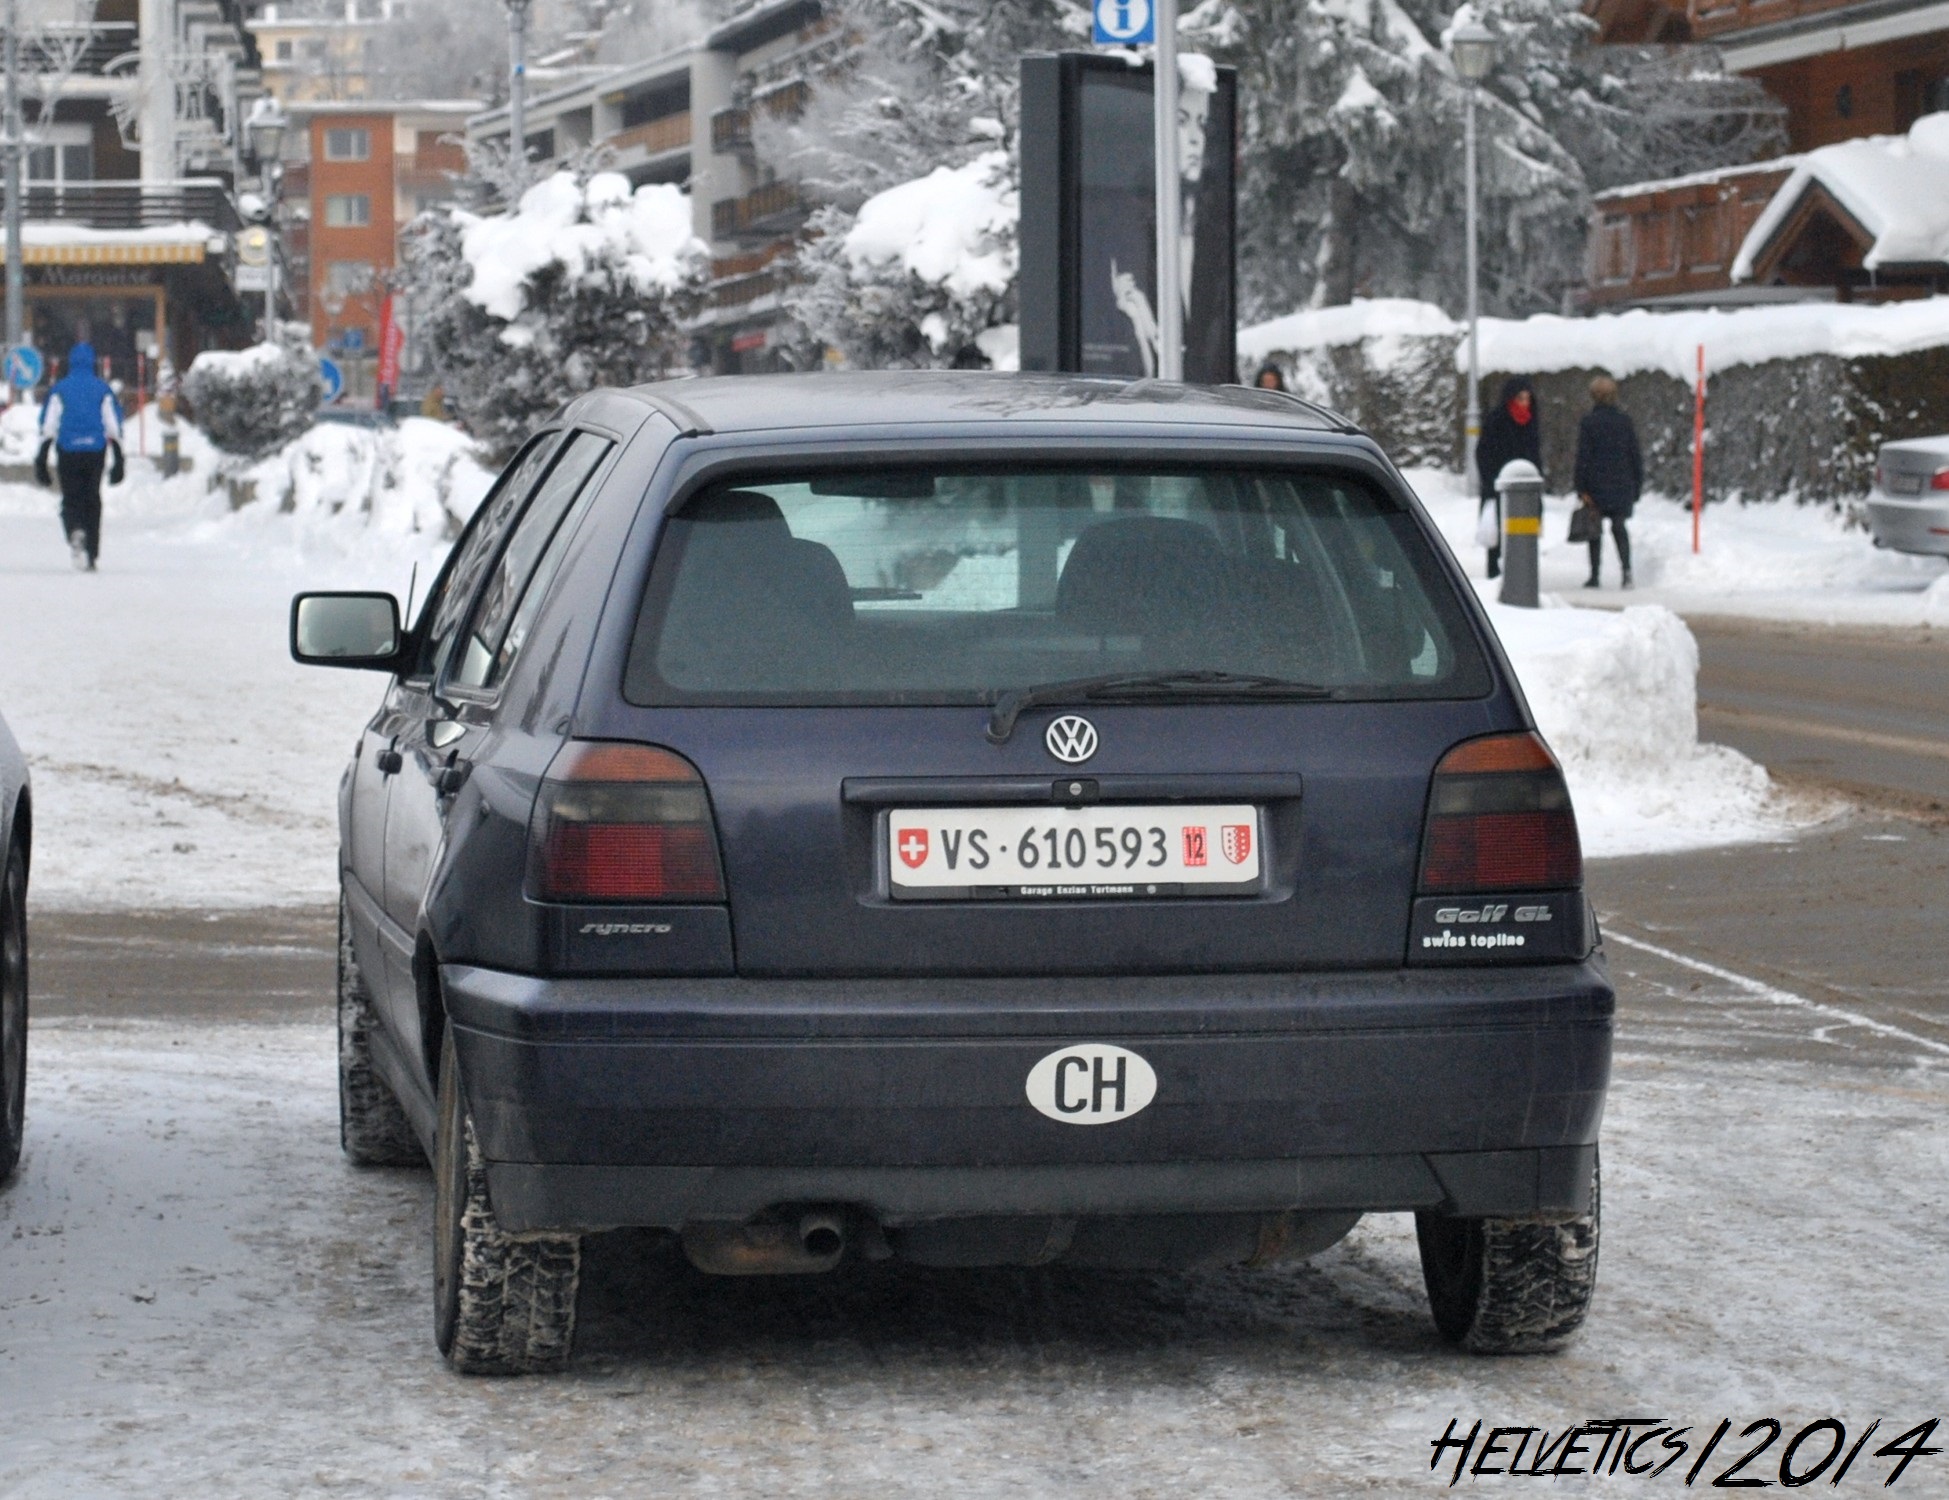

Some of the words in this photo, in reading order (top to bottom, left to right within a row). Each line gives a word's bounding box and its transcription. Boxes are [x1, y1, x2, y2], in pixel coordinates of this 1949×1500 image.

[1186, 833, 1204, 859] 12
[1020, 886, 1053, 896] Garage
[1435, 904, 1509, 924] Golf
[1514, 905, 1553, 922] GL
[579, 923, 671, 936] syncro
[1422, 929, 1466, 948] swiss
[1470, 932, 1525, 949] topline
[1054, 1055, 1127, 1114] CH
